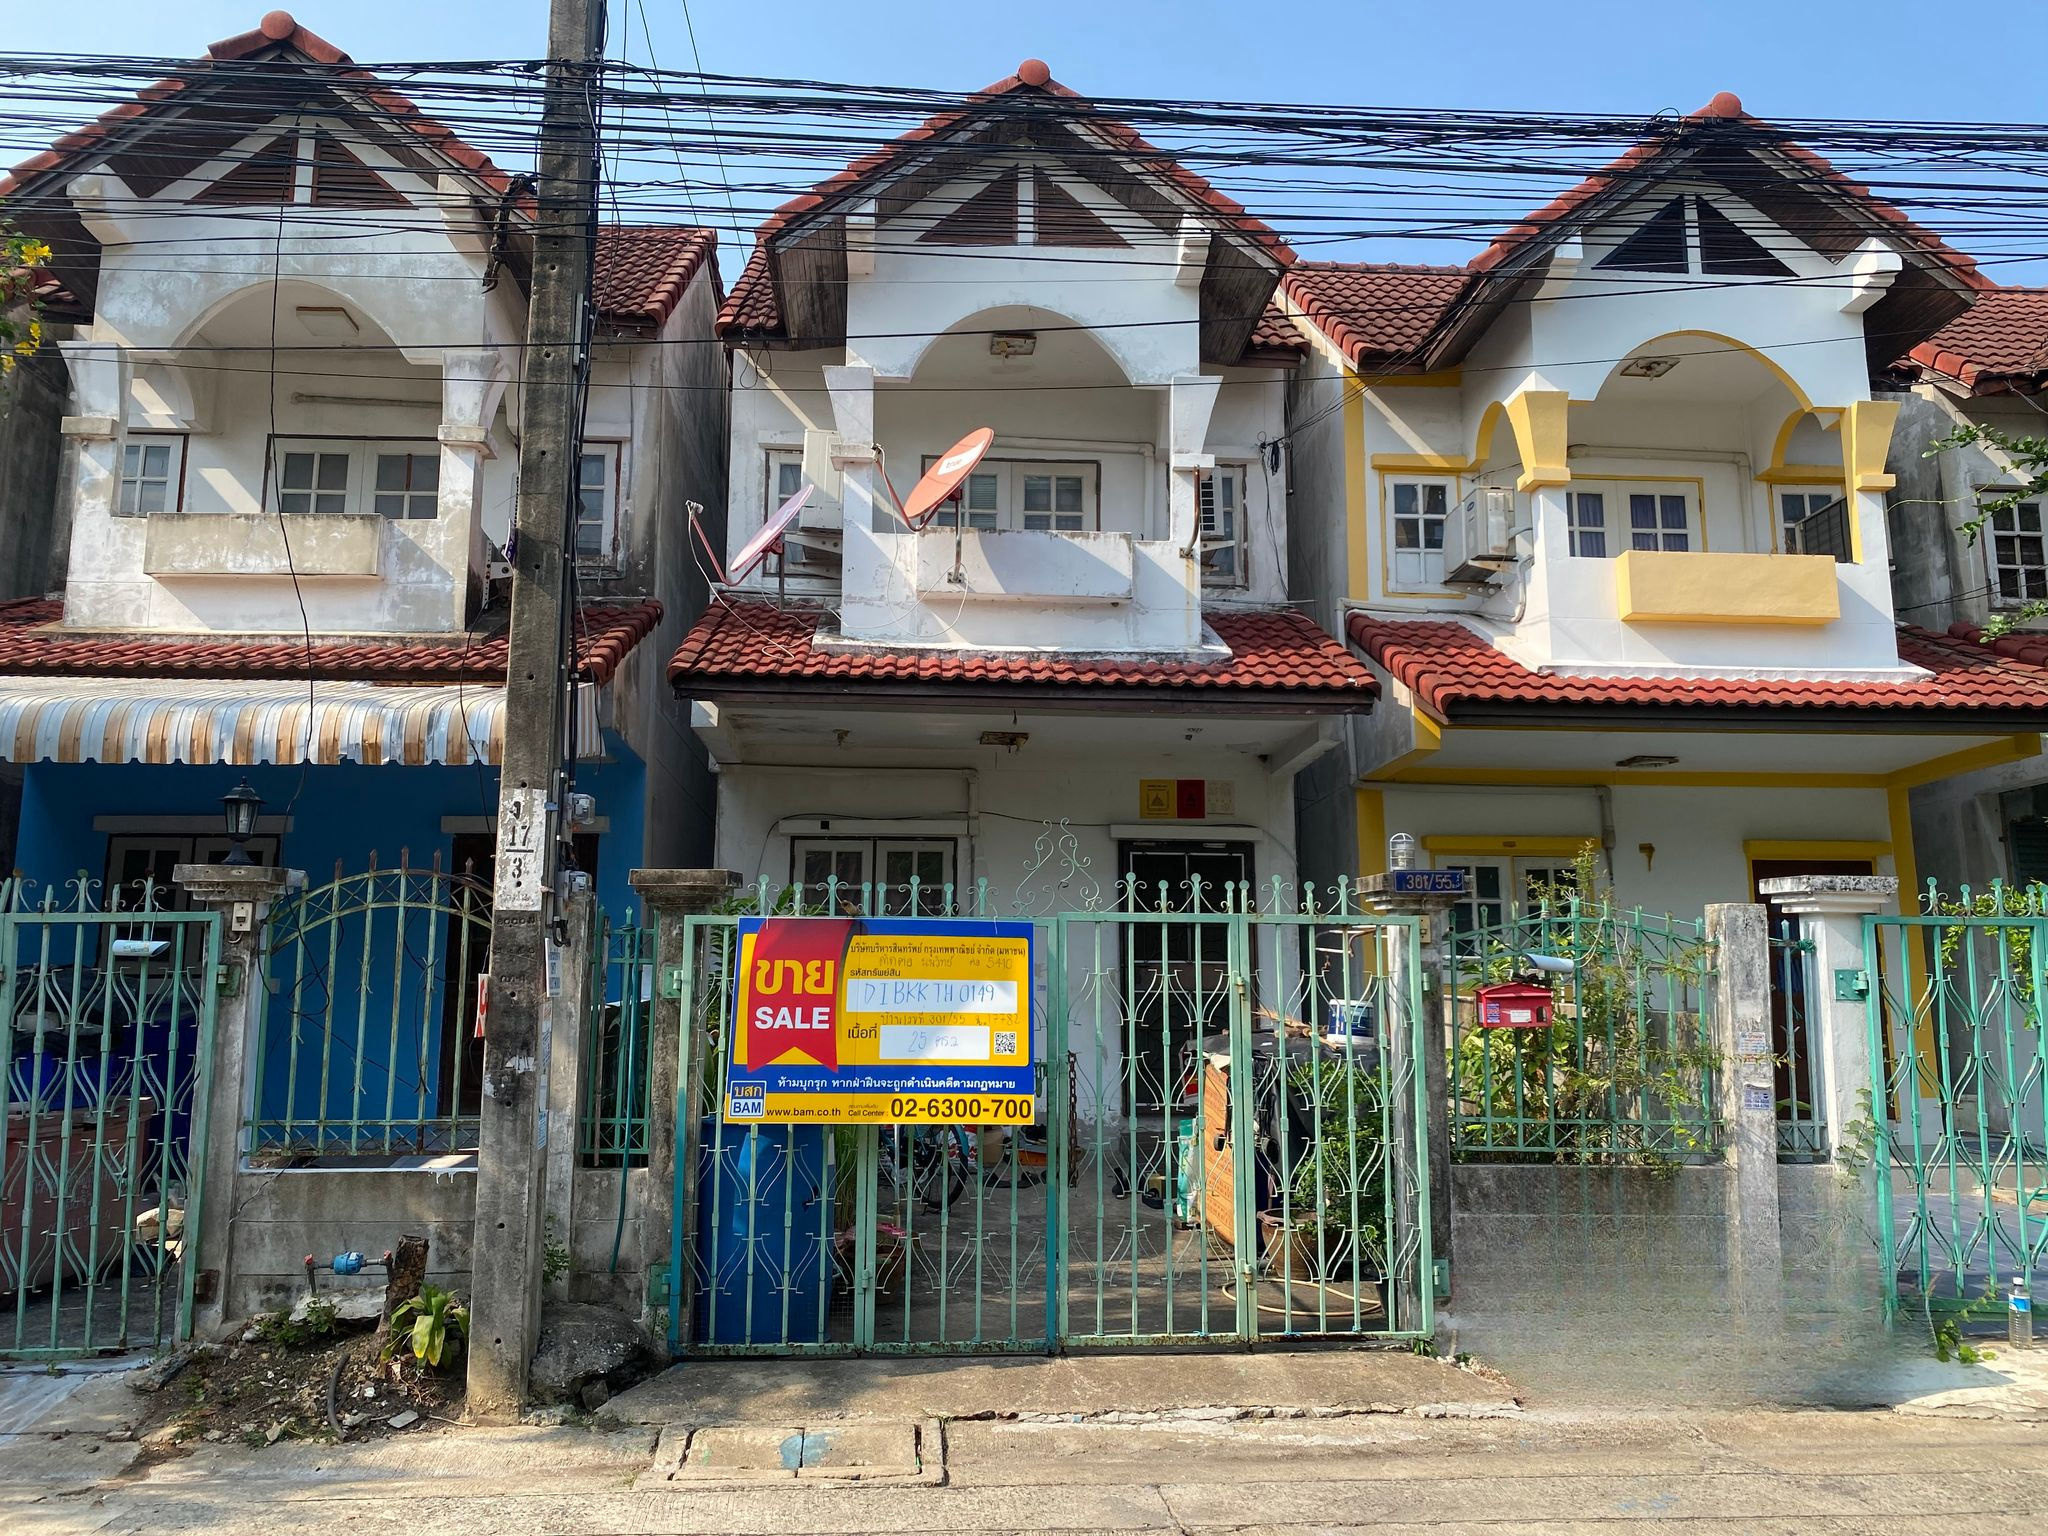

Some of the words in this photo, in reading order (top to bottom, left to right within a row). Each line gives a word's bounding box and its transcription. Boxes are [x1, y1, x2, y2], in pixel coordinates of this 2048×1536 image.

[509, 825, 531, 846] 17
[512, 857, 522, 879] 3
[996, 947, 1026, 957] (มหาชน)
[755, 959, 835, 995] ขาย
[850, 967, 901, 977] รหัสทรัพย์สิน
[754, 1006, 831, 1029] SALE
[848, 1022, 878, 1039] เนื้อที่
[908, 1031, 928, 1053] 25
[734, 1086, 764, 1097] บสก
[777, 1076, 828, 1091] ห้ามบุกรุก
[733, 1101, 762, 1114] BAM
[766, 1107, 841, 1117] www.bam.co.th
[848, 1109, 861, 1117] Call
[890, 1098, 1032, 1119] 02-6300-700
